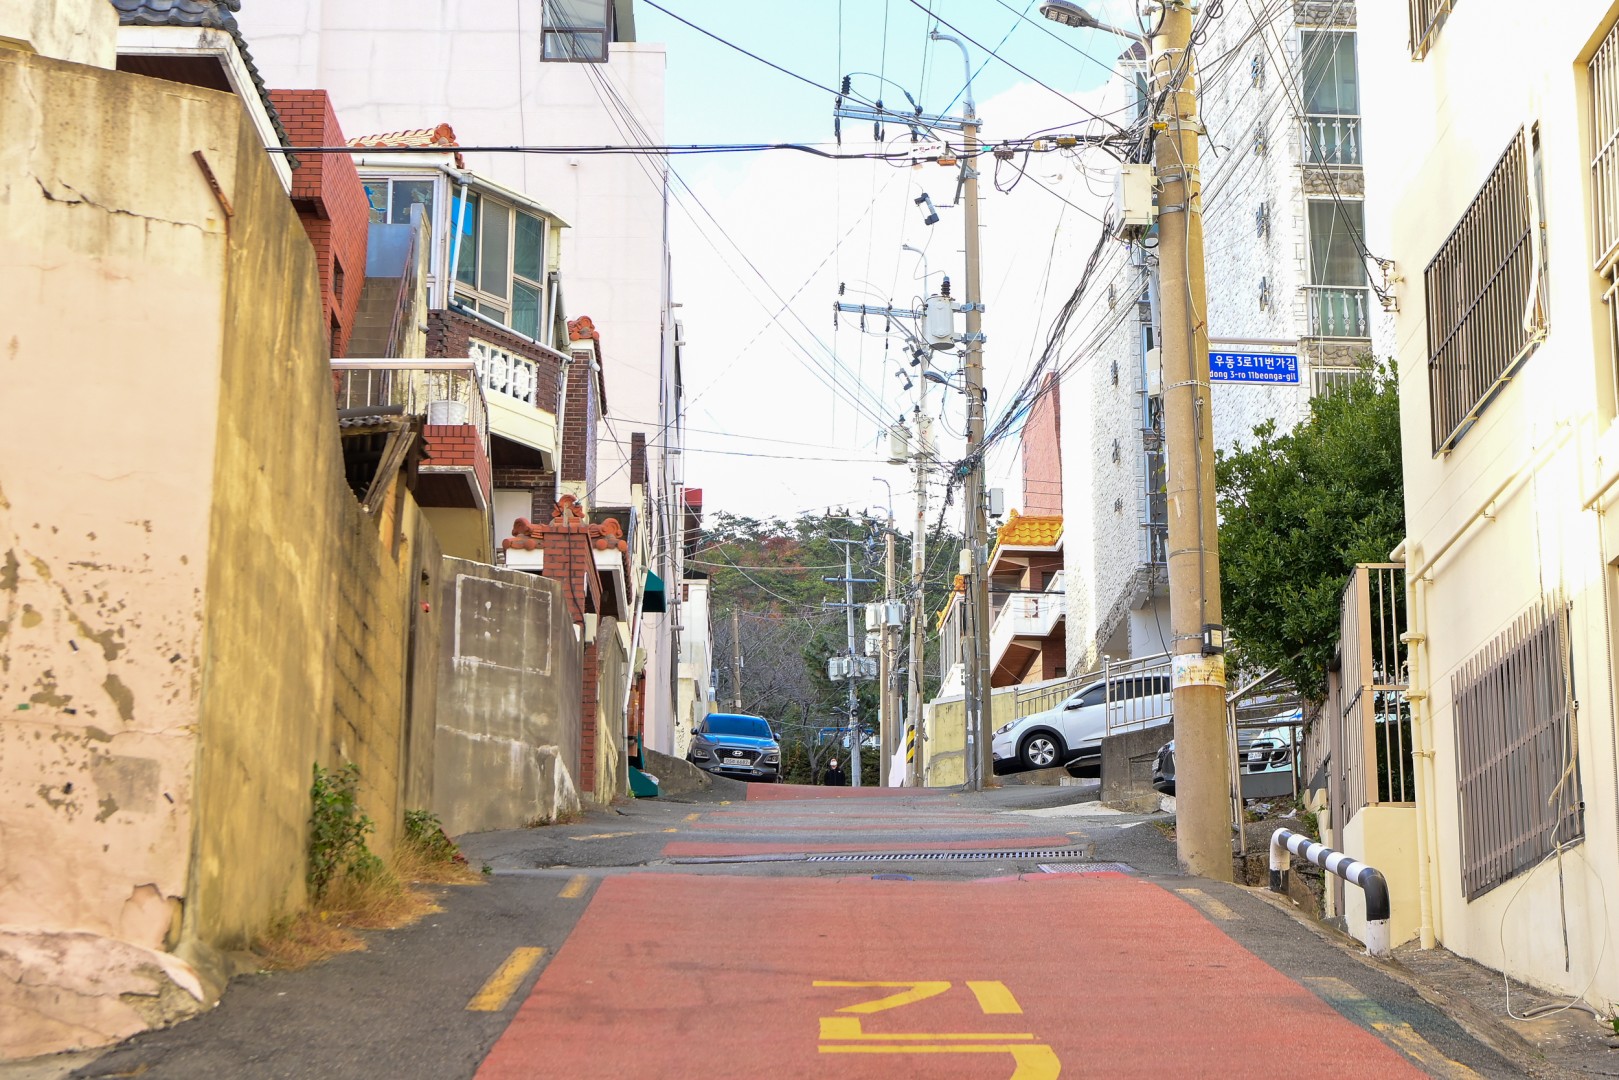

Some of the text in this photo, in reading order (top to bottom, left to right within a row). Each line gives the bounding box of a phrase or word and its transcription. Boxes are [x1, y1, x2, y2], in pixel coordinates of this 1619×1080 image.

[1214, 355, 1296, 371] 우동3로11번가길
[1230, 370, 1246, 379] 3-ro
[1248, 371, 1296, 381] 11beonga-gil
